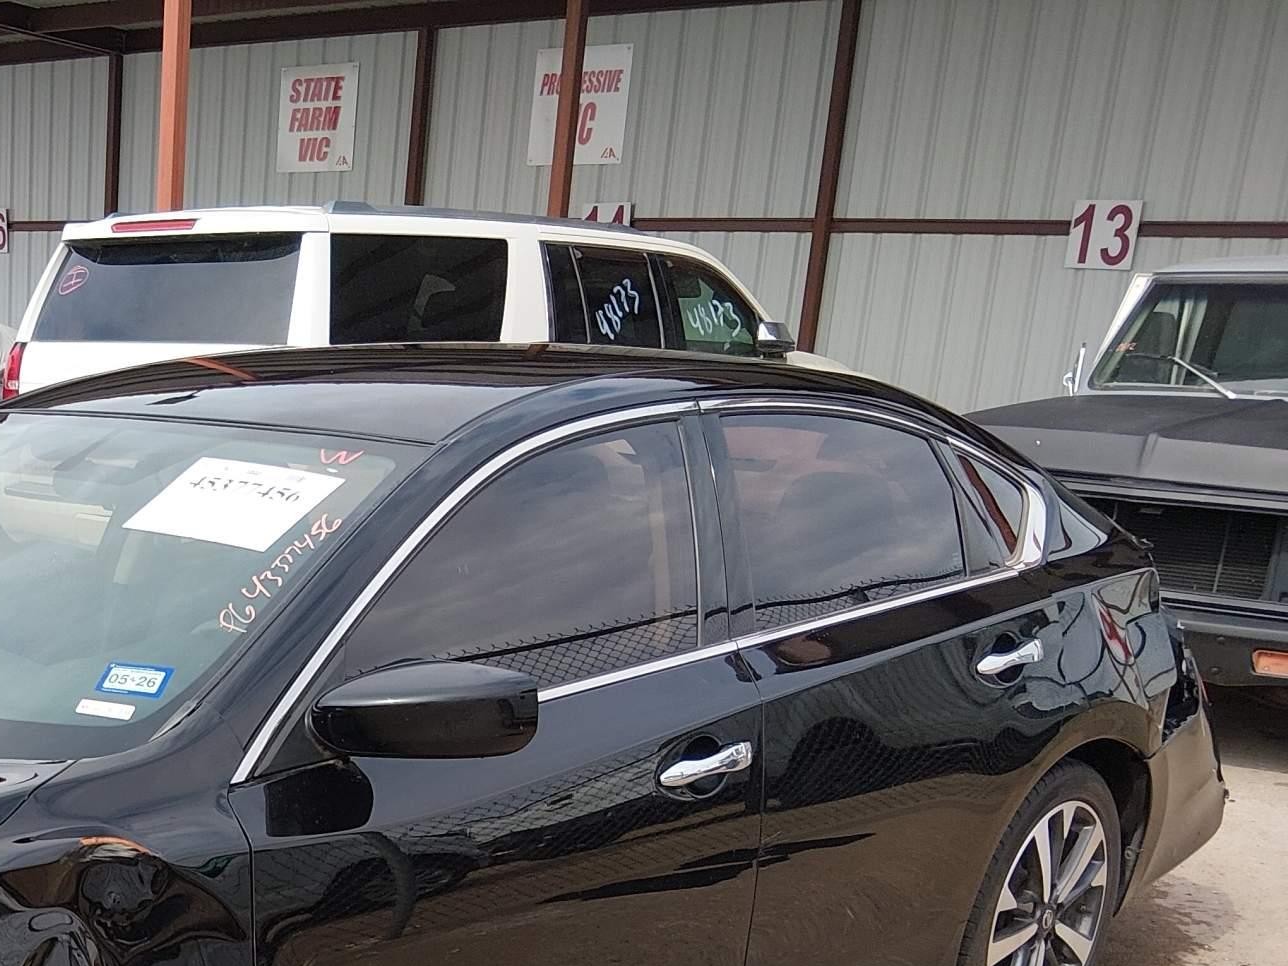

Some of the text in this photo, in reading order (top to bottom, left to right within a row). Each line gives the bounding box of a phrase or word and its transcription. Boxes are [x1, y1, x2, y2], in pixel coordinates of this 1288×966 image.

[290, 76, 345, 103] STATE
[540, 69, 624, 96] PRESSIVE
[289, 106, 341, 132] FARM
[298, 137, 330, 162] VIC
[1073, 204, 1133, 266] 13
[595, 278, 640, 341] 48173
[687, 299, 742, 337] 48173
